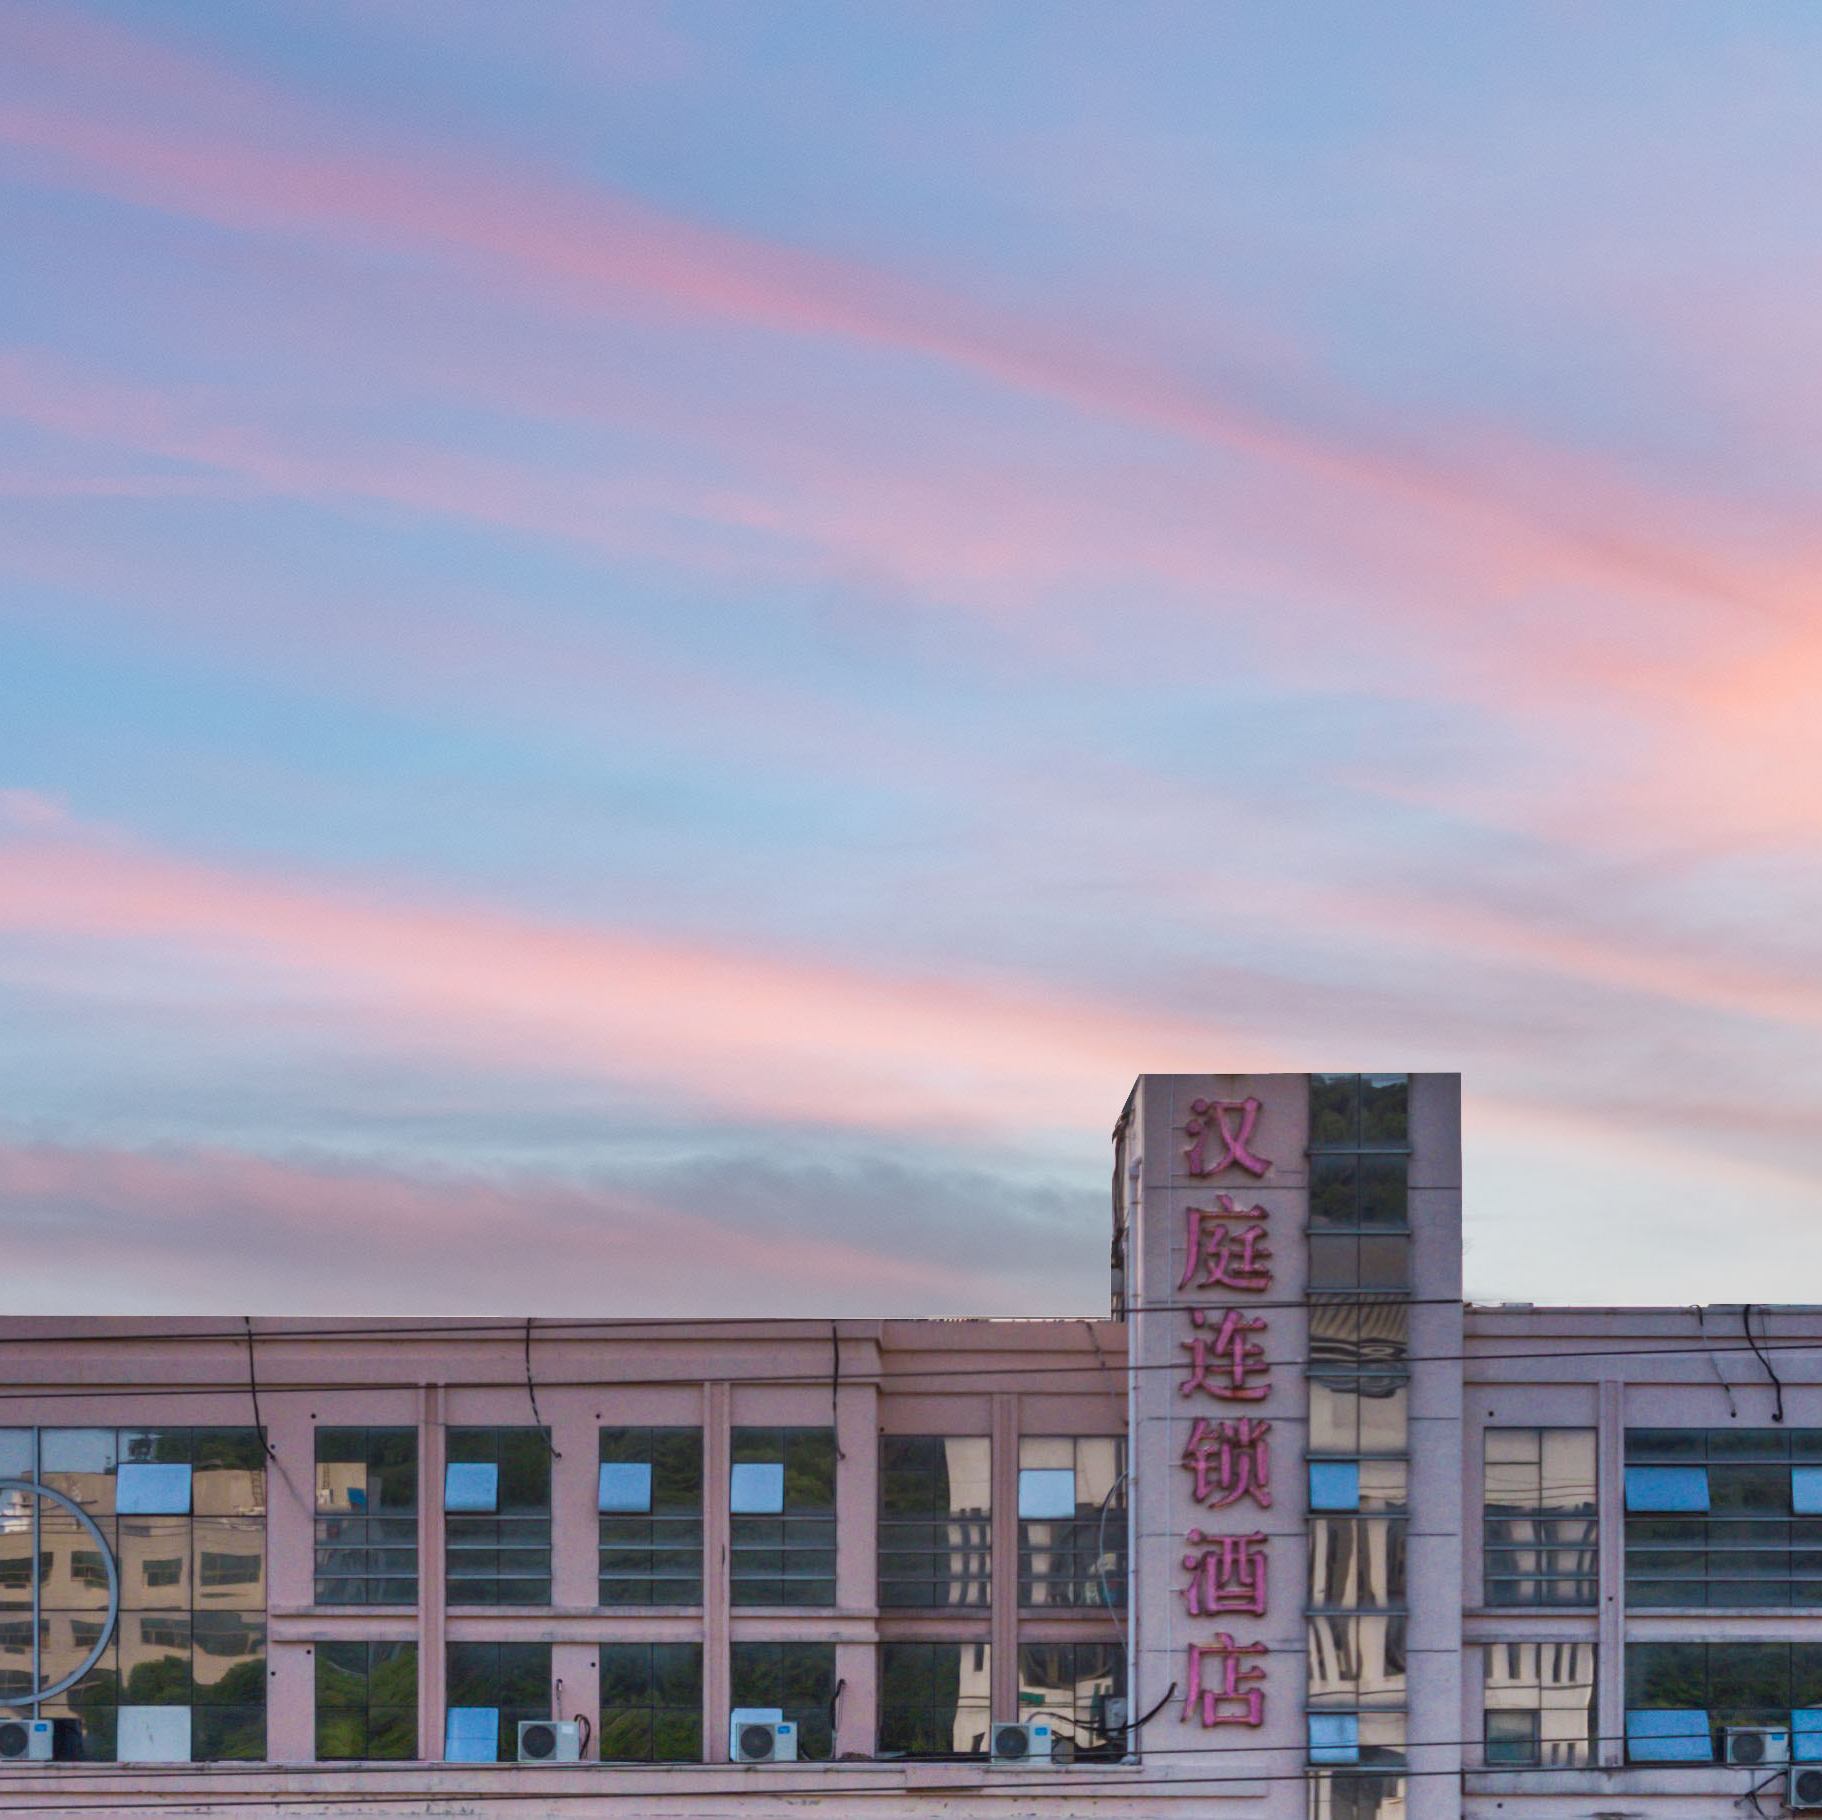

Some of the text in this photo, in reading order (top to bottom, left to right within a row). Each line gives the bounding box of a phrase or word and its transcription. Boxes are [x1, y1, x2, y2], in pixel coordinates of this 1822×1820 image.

[1179, 1096, 1273, 1730] 汉庭连锁酒店
